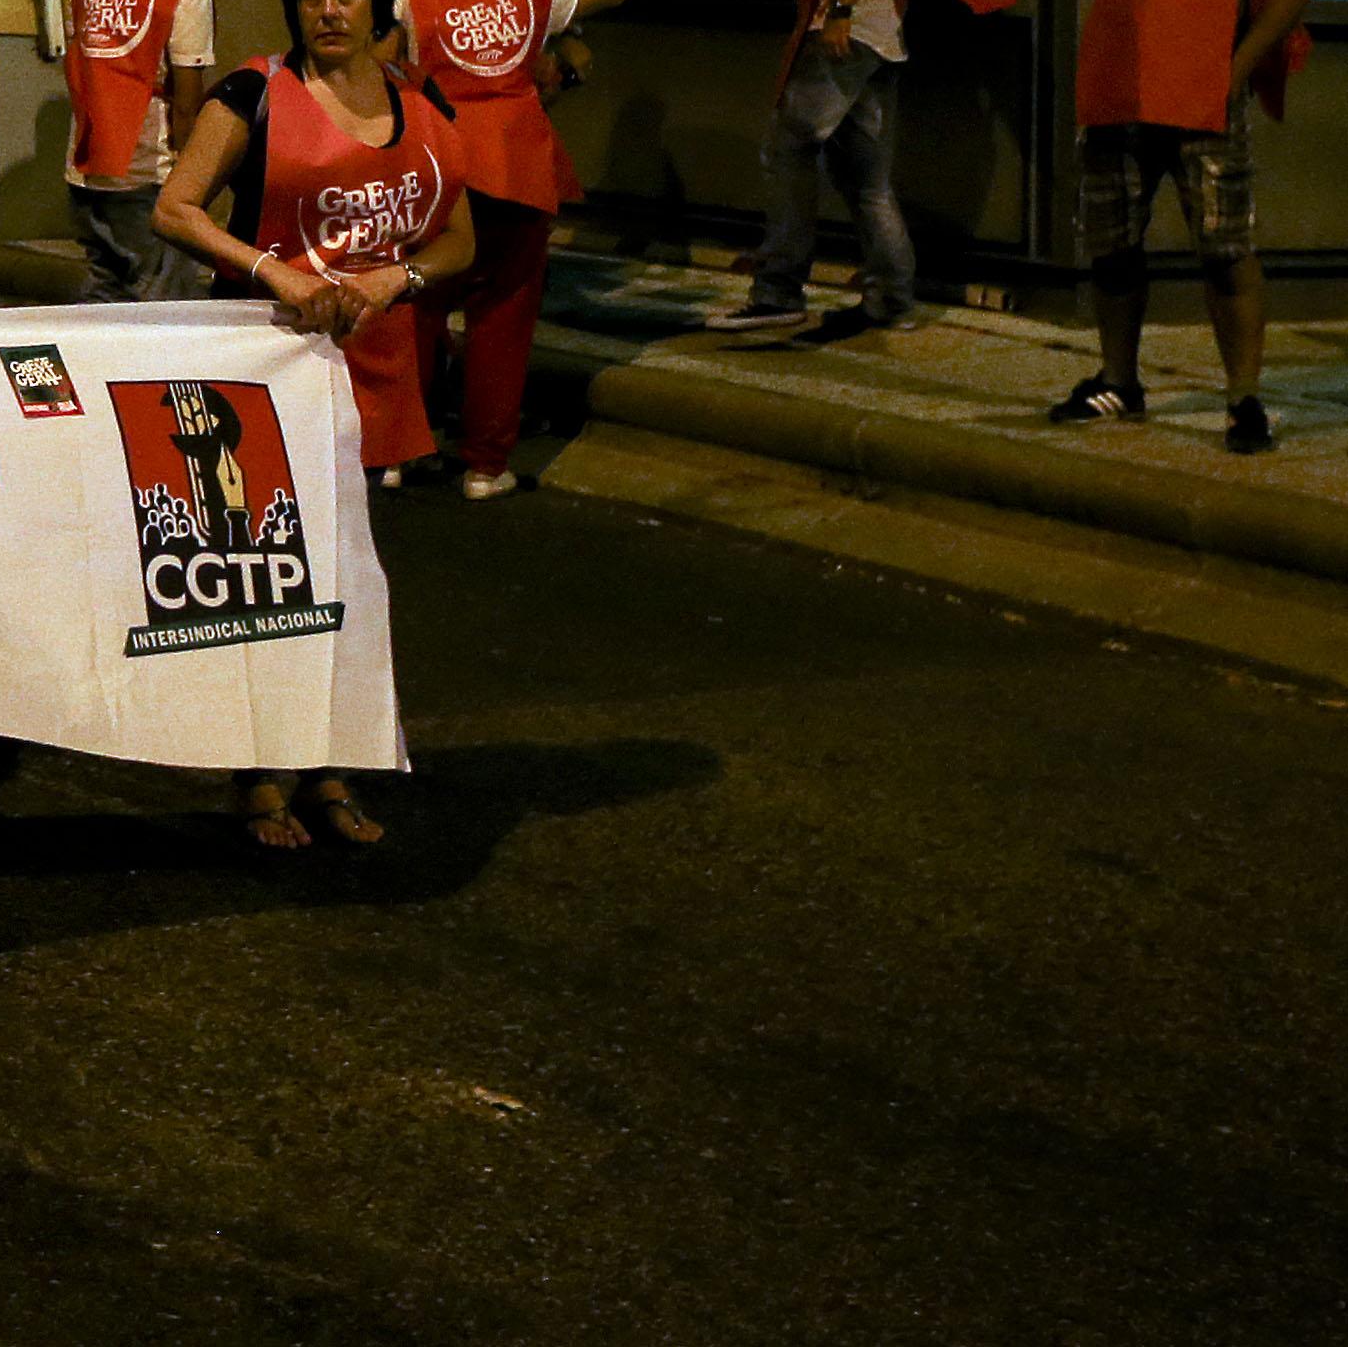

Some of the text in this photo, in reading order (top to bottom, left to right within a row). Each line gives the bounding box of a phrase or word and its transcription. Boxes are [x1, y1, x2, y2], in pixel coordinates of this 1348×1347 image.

[83, 7, 139, 36] ERAL
[452, 14, 527, 51] GERAL
[316, 171, 423, 217] GREVE
[318, 202, 423, 254] GERAL
[15, 368, 63, 387] GERAL
[145, 552, 305, 610] CGTP
[132, 609, 336, 650] INTERSINDICAL NACIONAL
